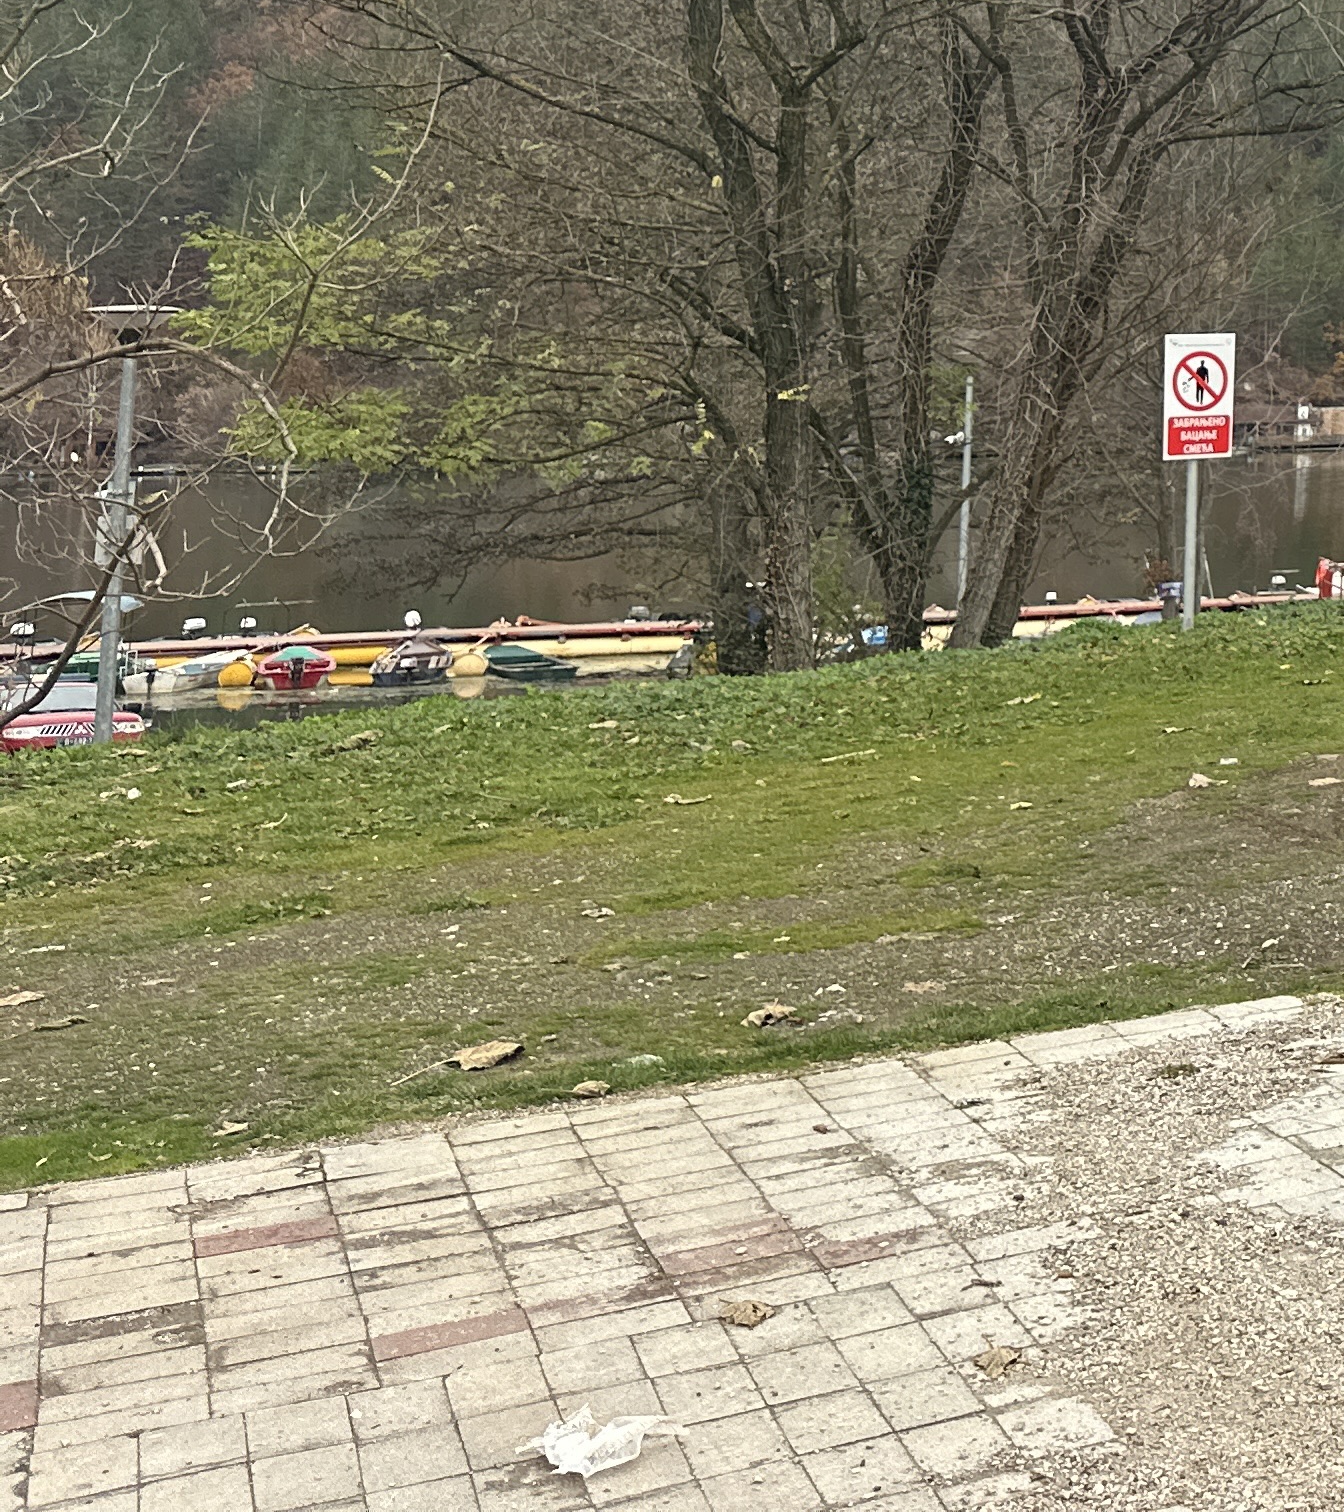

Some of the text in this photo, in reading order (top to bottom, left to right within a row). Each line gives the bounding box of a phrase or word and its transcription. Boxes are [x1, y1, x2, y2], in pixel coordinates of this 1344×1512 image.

[1173, 417, 1226, 428] ЗАБРАЊЕНО
[1180, 430, 1218, 441] БАЦАЊЕ
[1183, 443, 1214, 454] СМЕЋА
